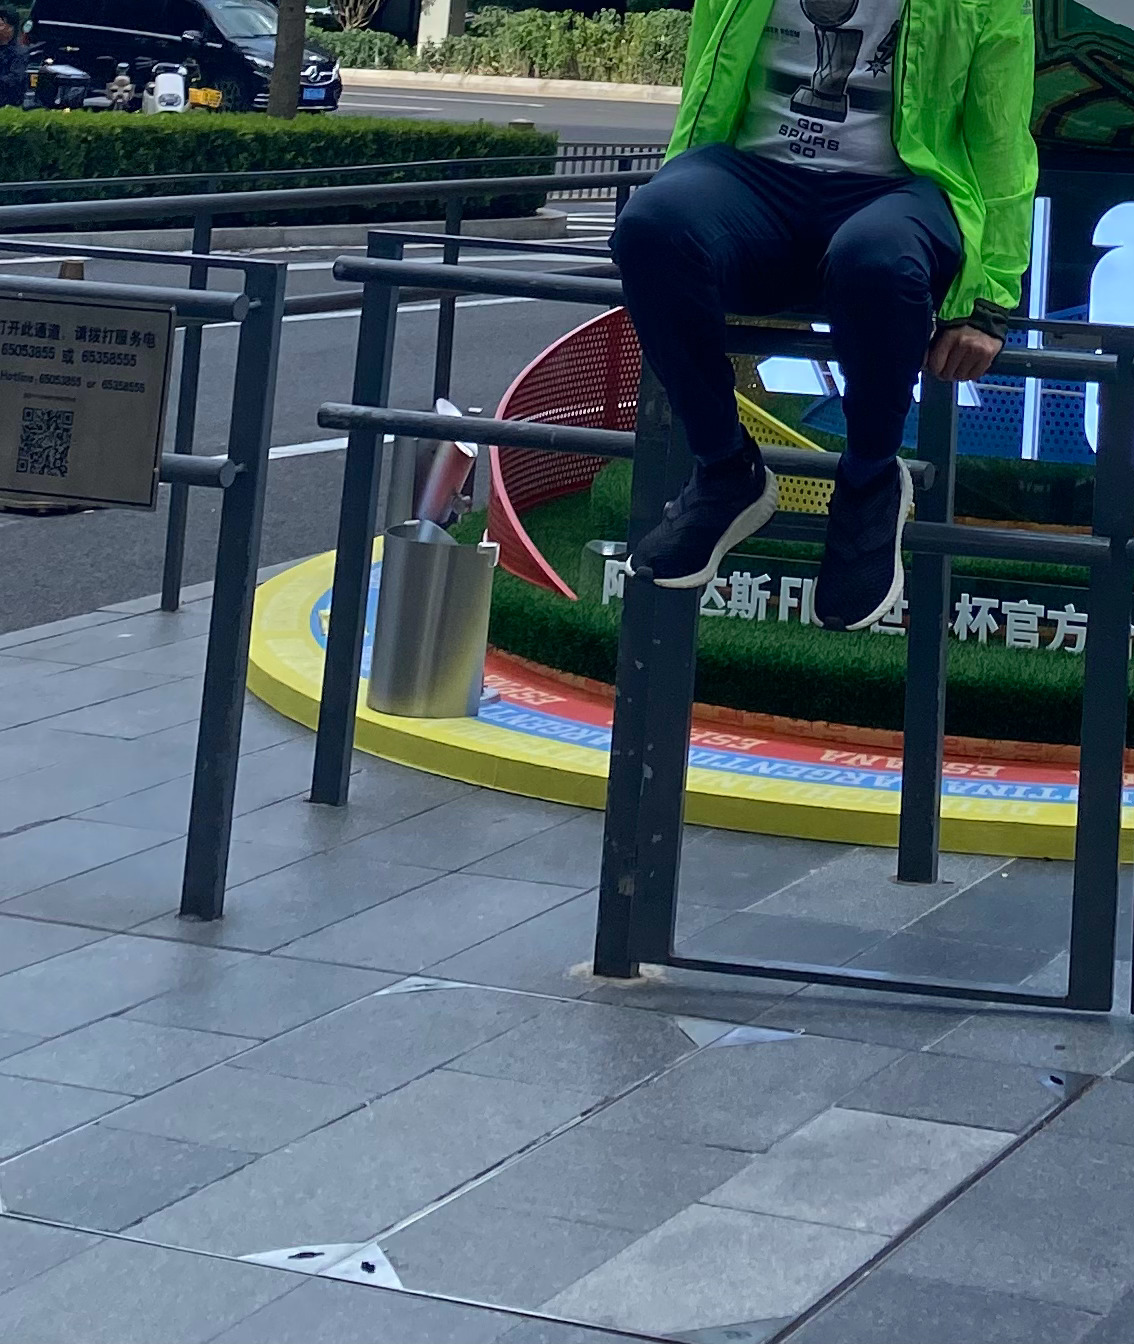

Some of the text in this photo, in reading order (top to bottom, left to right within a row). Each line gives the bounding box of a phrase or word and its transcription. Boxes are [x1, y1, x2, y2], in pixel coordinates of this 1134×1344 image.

[797, 117, 824, 134] GO
[778, 123, 840, 152] SPURS
[789, 142, 816, 159] GO
[61, 347, 75, 365] 或
